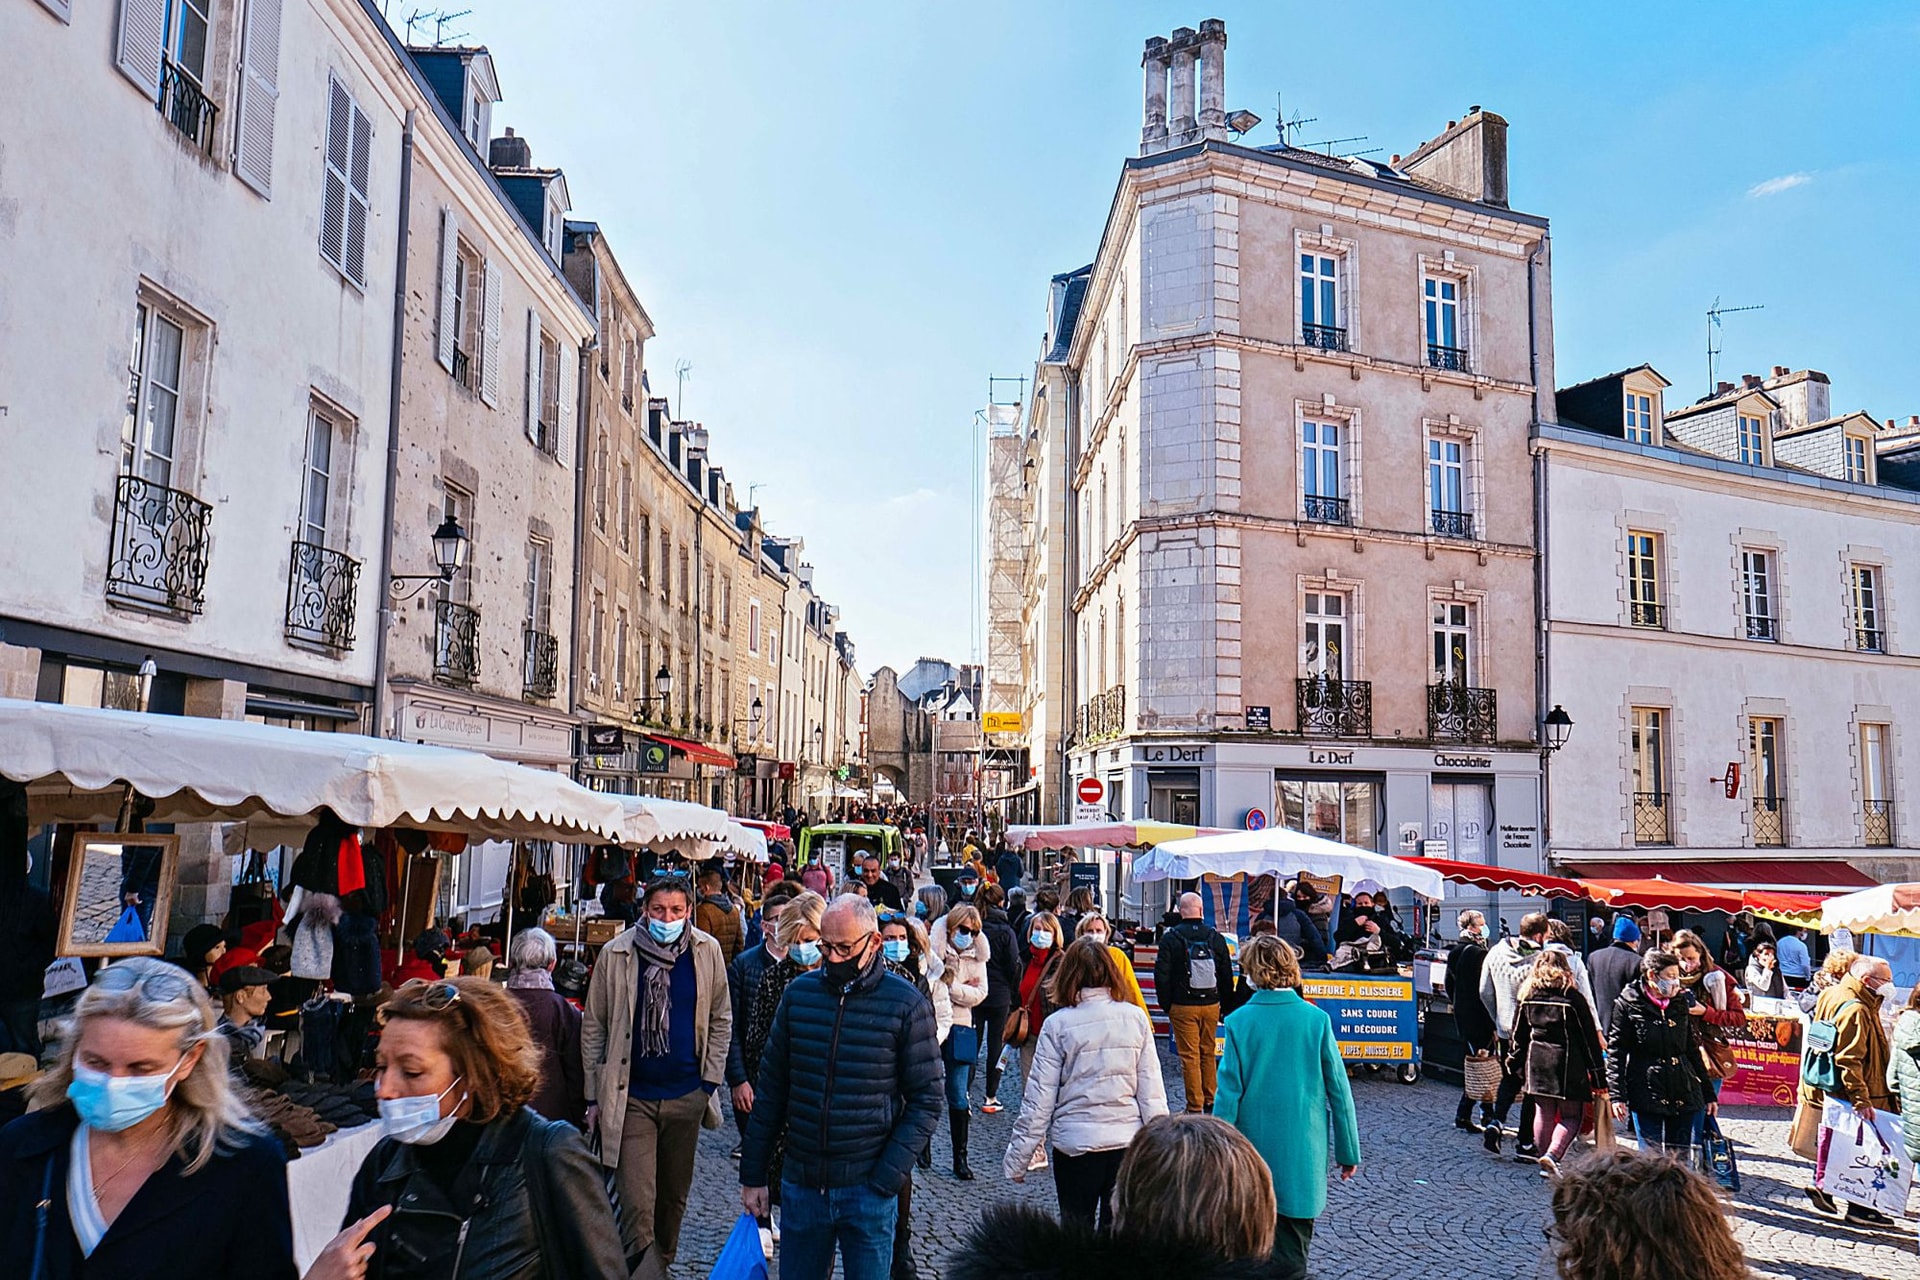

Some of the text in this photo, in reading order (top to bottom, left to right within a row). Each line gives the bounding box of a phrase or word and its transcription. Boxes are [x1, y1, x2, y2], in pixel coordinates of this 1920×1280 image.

[1143, 745, 1206, 761] Le Derf
[1308, 751, 1354, 764] Le Derf
[1434, 754, 1492, 768] Chocolatier
[1726, 765, 1734, 796] TABAC
[1303, 984, 1403, 997] RMETURE À GLISSIÈRE
[1341, 1008, 1397, 1019] SANS COUDRE
[1341, 1023, 1397, 1034] NI DÉCOUDRE
